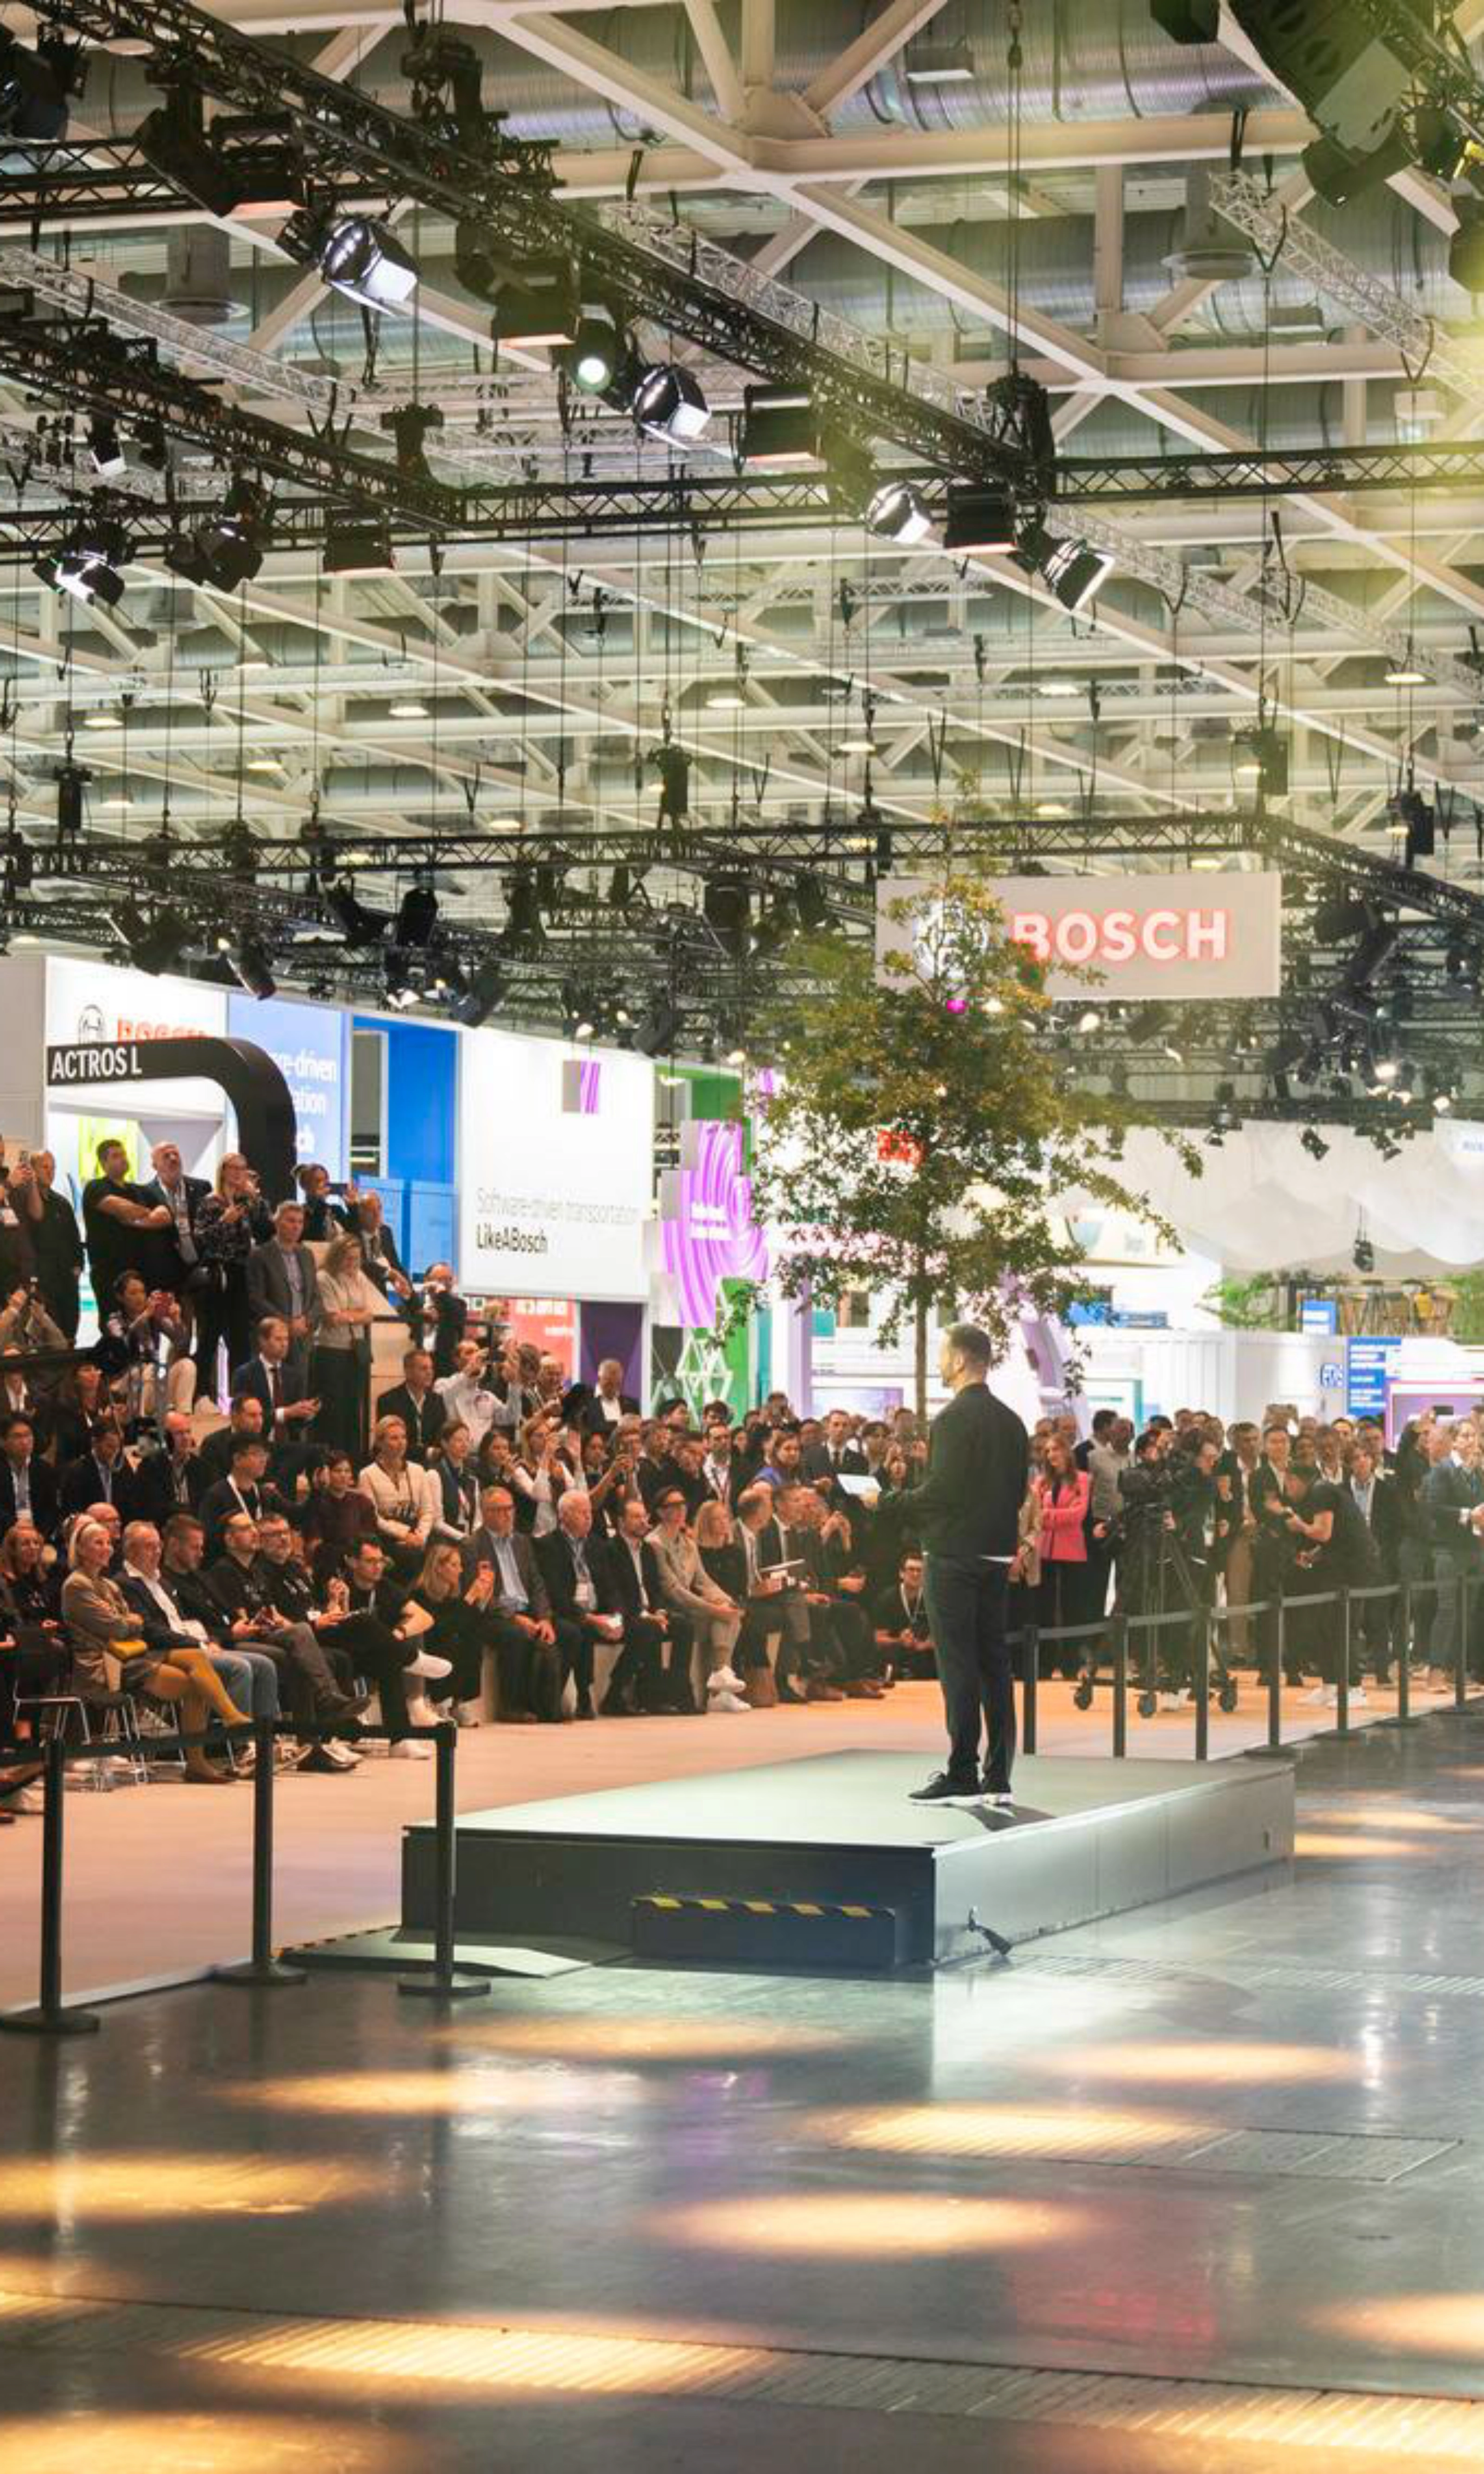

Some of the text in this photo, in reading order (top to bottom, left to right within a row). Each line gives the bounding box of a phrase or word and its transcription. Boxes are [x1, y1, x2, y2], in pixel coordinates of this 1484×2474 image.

[1013, 911, 1226, 962] BOSCH
[51, 1045, 142, 1080] ACTROS L
[270, 1049, 338, 1084] re-driven
[476, 1222, 548, 1254] LikeABosch
